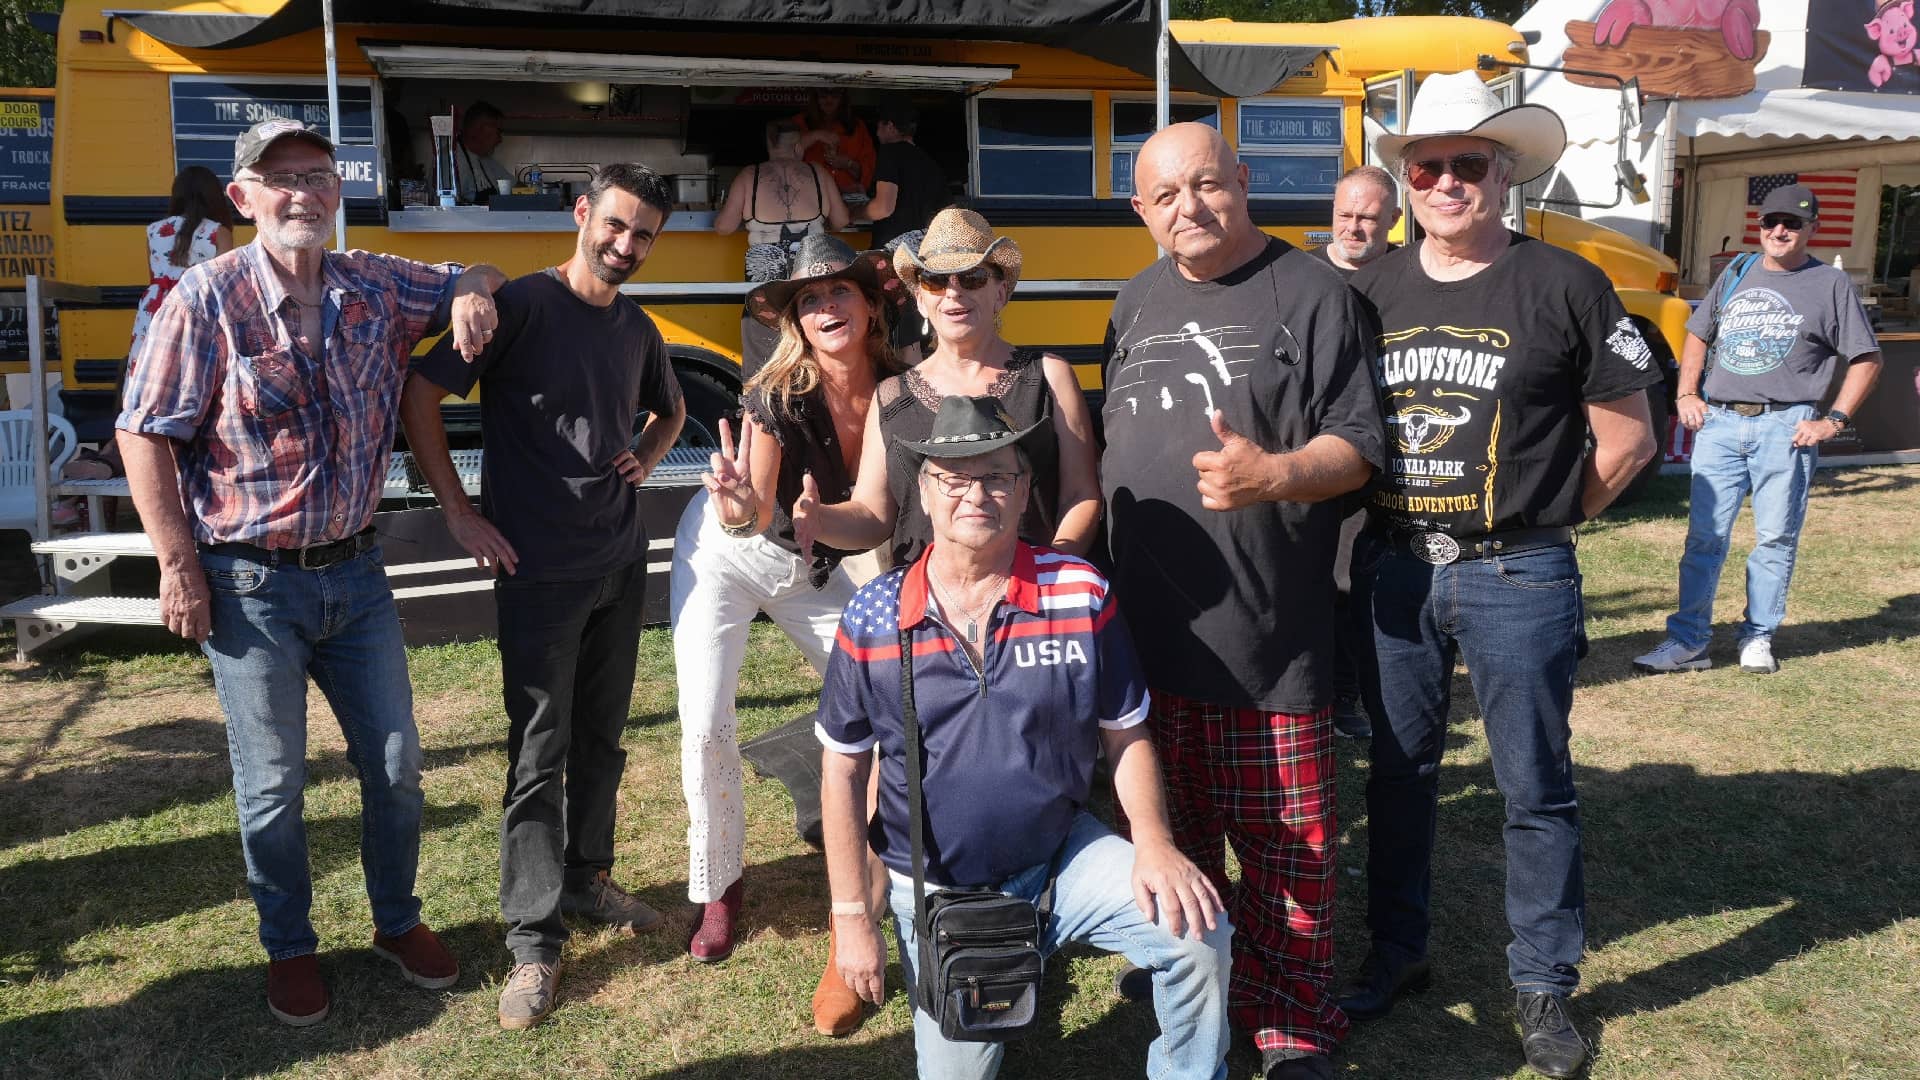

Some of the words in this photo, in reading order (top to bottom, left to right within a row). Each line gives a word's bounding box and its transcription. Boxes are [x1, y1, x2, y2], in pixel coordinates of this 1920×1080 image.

[4, 103, 38, 114] DOOR
[214, 103, 240, 120] THE
[245, 103, 294, 121] SCHOOL
[303, 104, 329, 122] BUS
[0, 116, 38, 127] COURS
[1246, 120, 1265, 136] THE
[1269, 120, 1308, 136] SCHOOL
[1312, 120, 1332, 137] BUS
[11, 150, 50, 164] TRUCK
[0, 211, 32, 231] TEZ
[1728, 299, 1771, 317] Blues
[1429, 460, 1465, 477] PARK
[1408, 494, 1479, 513] ADVENTURE
[1014, 640, 1088, 668] USA
